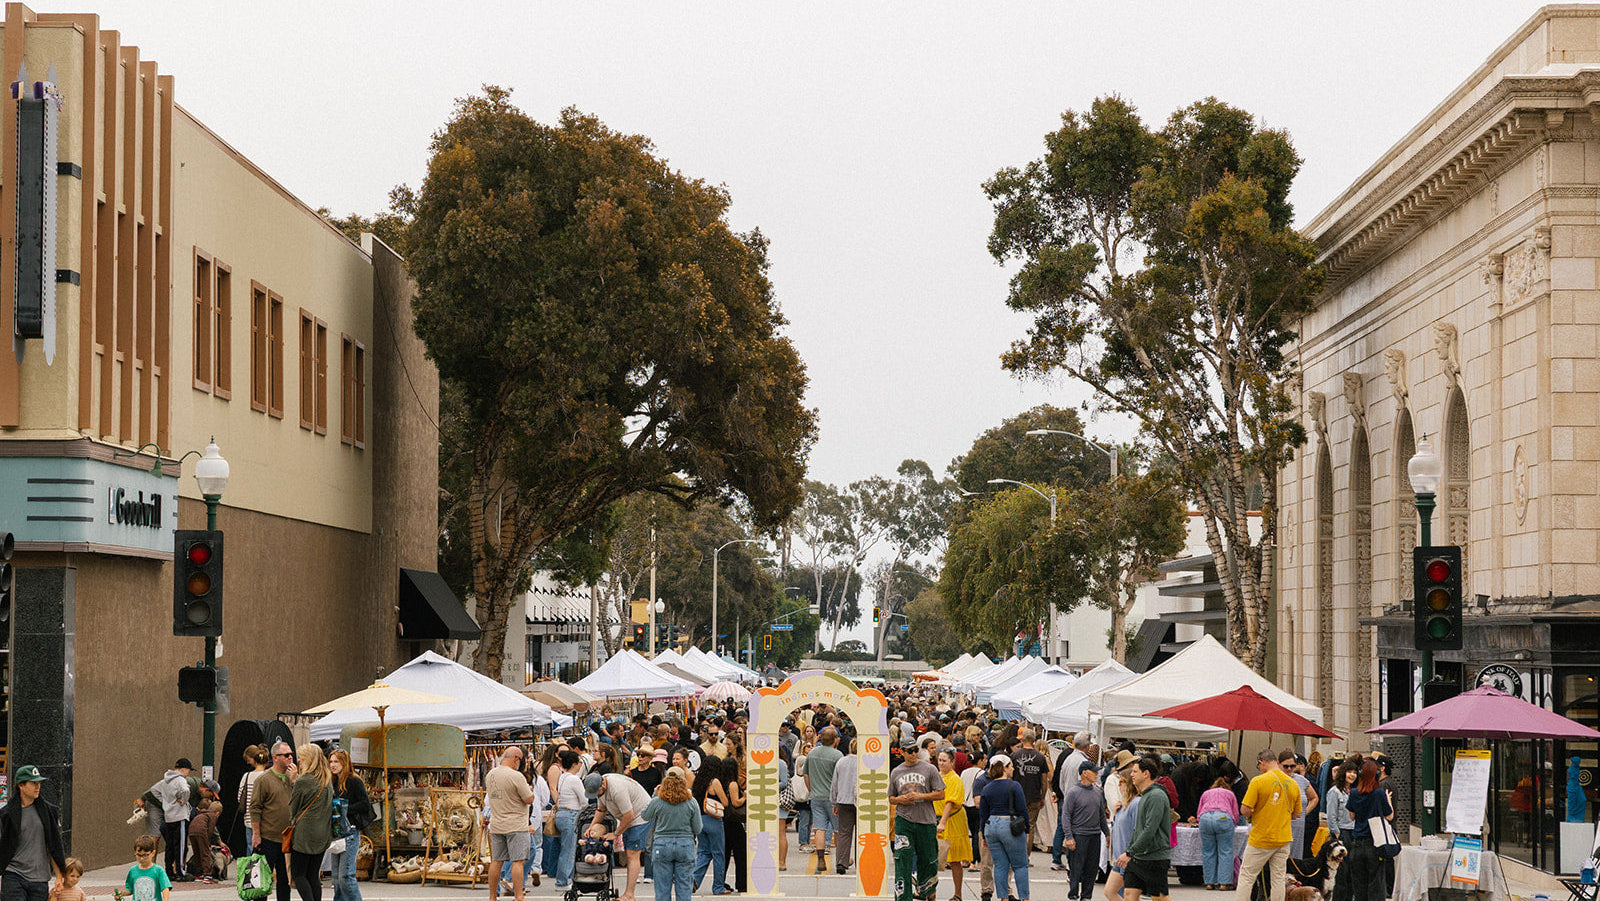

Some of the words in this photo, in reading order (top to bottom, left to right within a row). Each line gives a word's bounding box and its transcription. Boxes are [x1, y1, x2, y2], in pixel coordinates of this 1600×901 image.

[116, 487, 162, 529] Goodwill
[1506, 668, 1521, 686] ITALY
[777, 691, 820, 706] findings
[823, 691, 861, 707] market
[899, 772, 926, 788] NIKE
